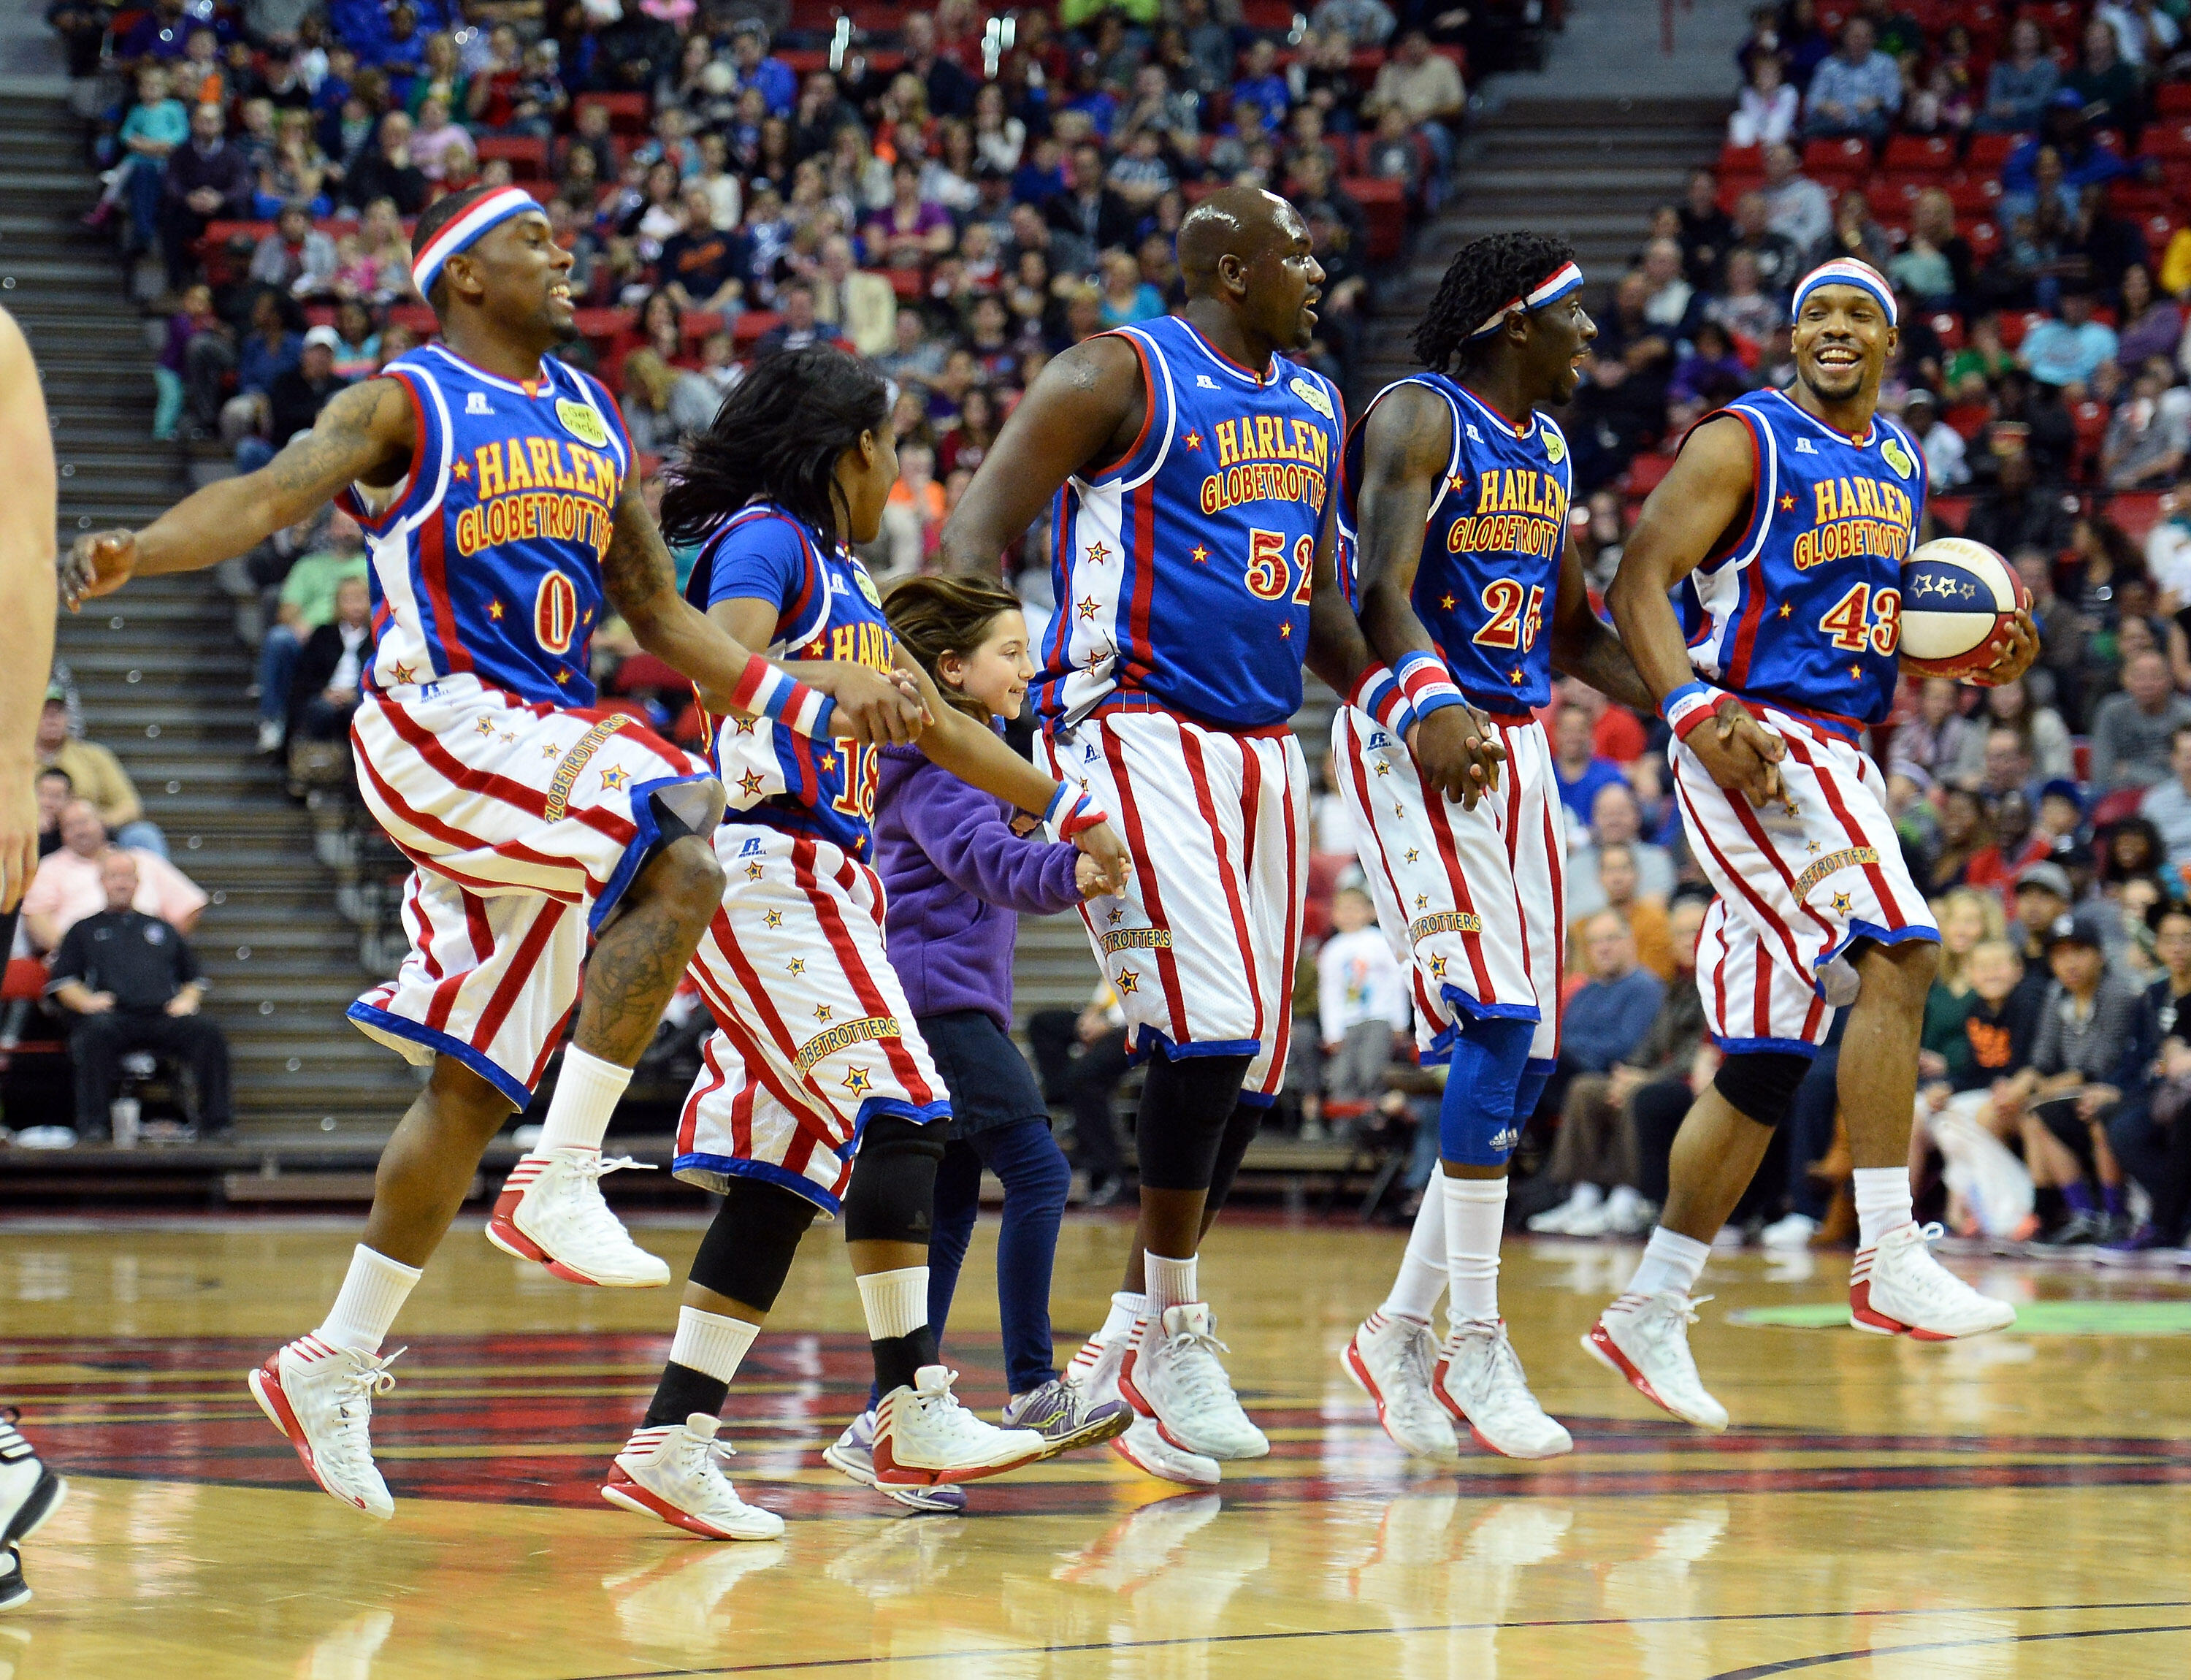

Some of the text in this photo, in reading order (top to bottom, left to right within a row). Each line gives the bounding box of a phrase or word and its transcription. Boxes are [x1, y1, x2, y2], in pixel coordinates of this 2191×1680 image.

[567, 407, 591, 421] Get
[1215, 415, 1328, 475] HARLEM
[475, 436, 616, 510] HARLEM
[1814, 476, 1912, 535] HARLEM
[1244, 527, 1314, 606] 52
[535, 570, 576, 654] 0
[1472, 578, 1545, 654] 25
[1819, 581, 1901, 657] 43
[832, 736, 879, 822] 18
